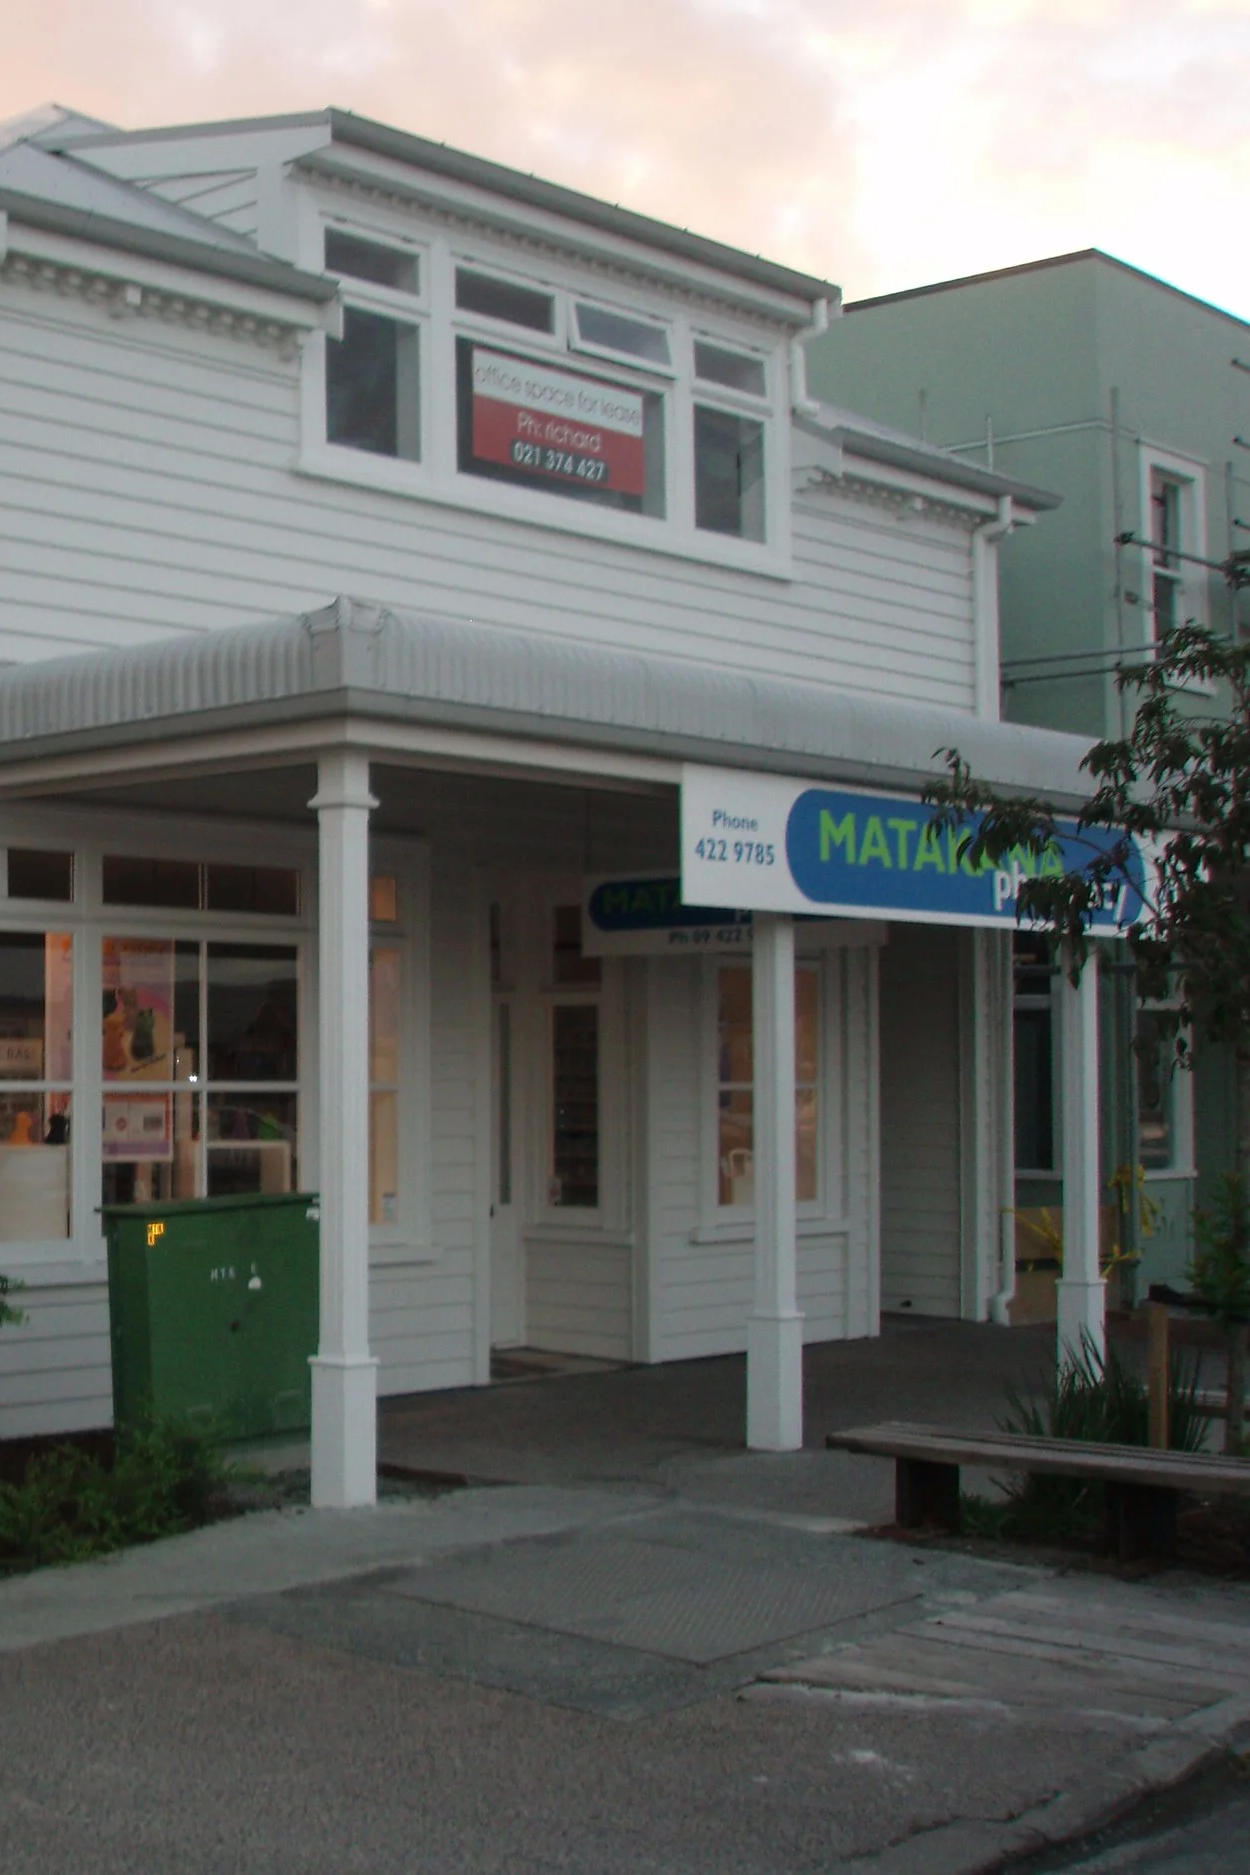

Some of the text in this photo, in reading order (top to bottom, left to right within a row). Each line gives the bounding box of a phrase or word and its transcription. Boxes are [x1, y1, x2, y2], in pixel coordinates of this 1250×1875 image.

[475, 366, 639, 425] office space for lease
[514, 441, 605, 480] 021 374 427
[712, 809, 758, 831] Phone
[695, 838, 775, 866] 422 9785
